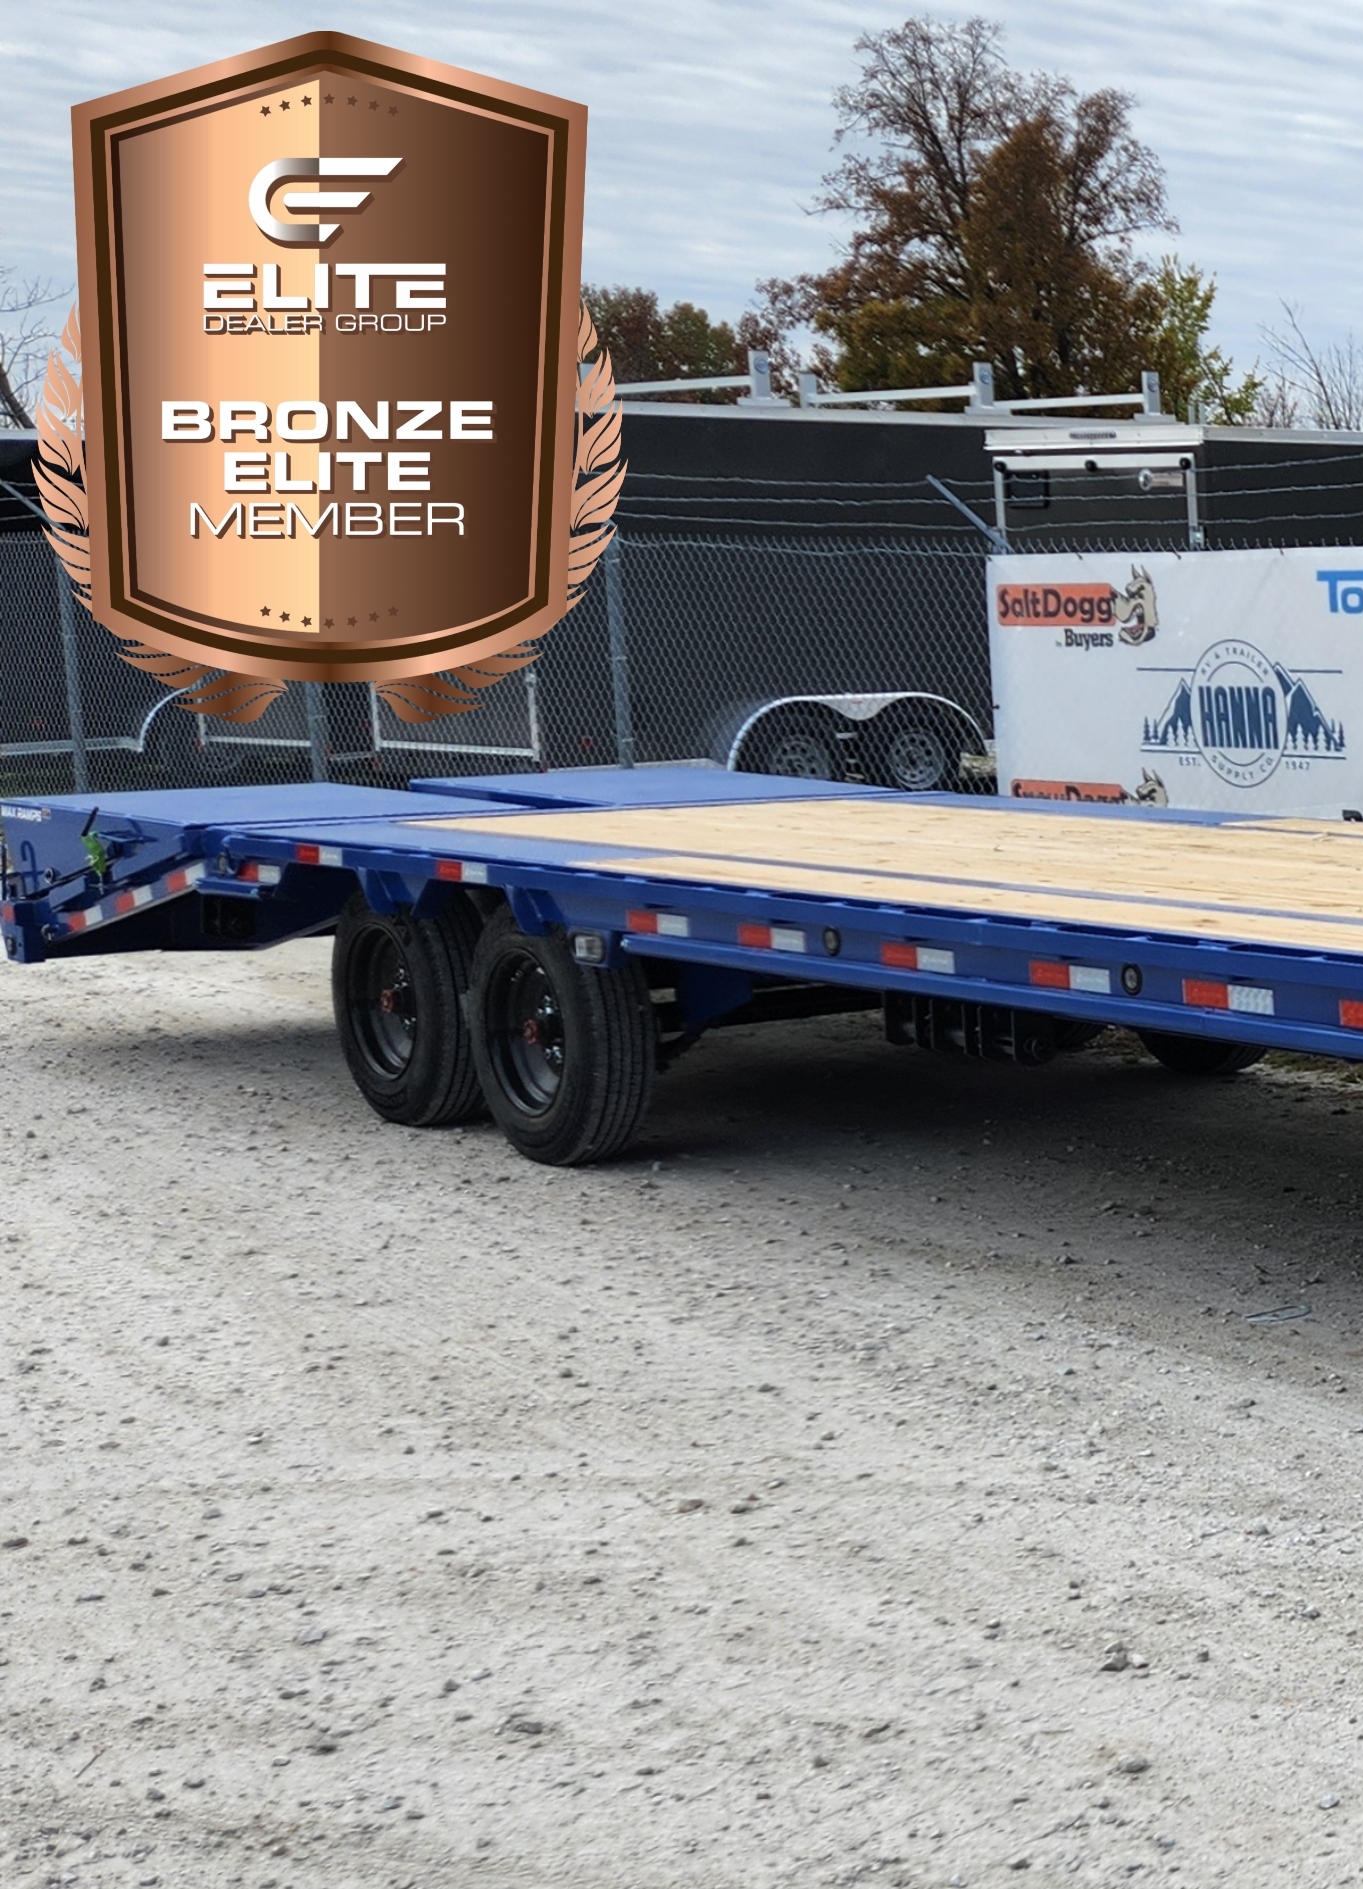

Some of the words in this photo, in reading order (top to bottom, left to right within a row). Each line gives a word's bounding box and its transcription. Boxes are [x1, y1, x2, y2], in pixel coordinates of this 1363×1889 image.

[1064, 629, 1114, 651] Buyers
[1225, 647, 1269, 676] TRAILER
[1198, 686, 1280, 750] HANNA
[1211, 755, 1255, 781] SUPPLY
[1285, 760, 1310, 771] 1947
